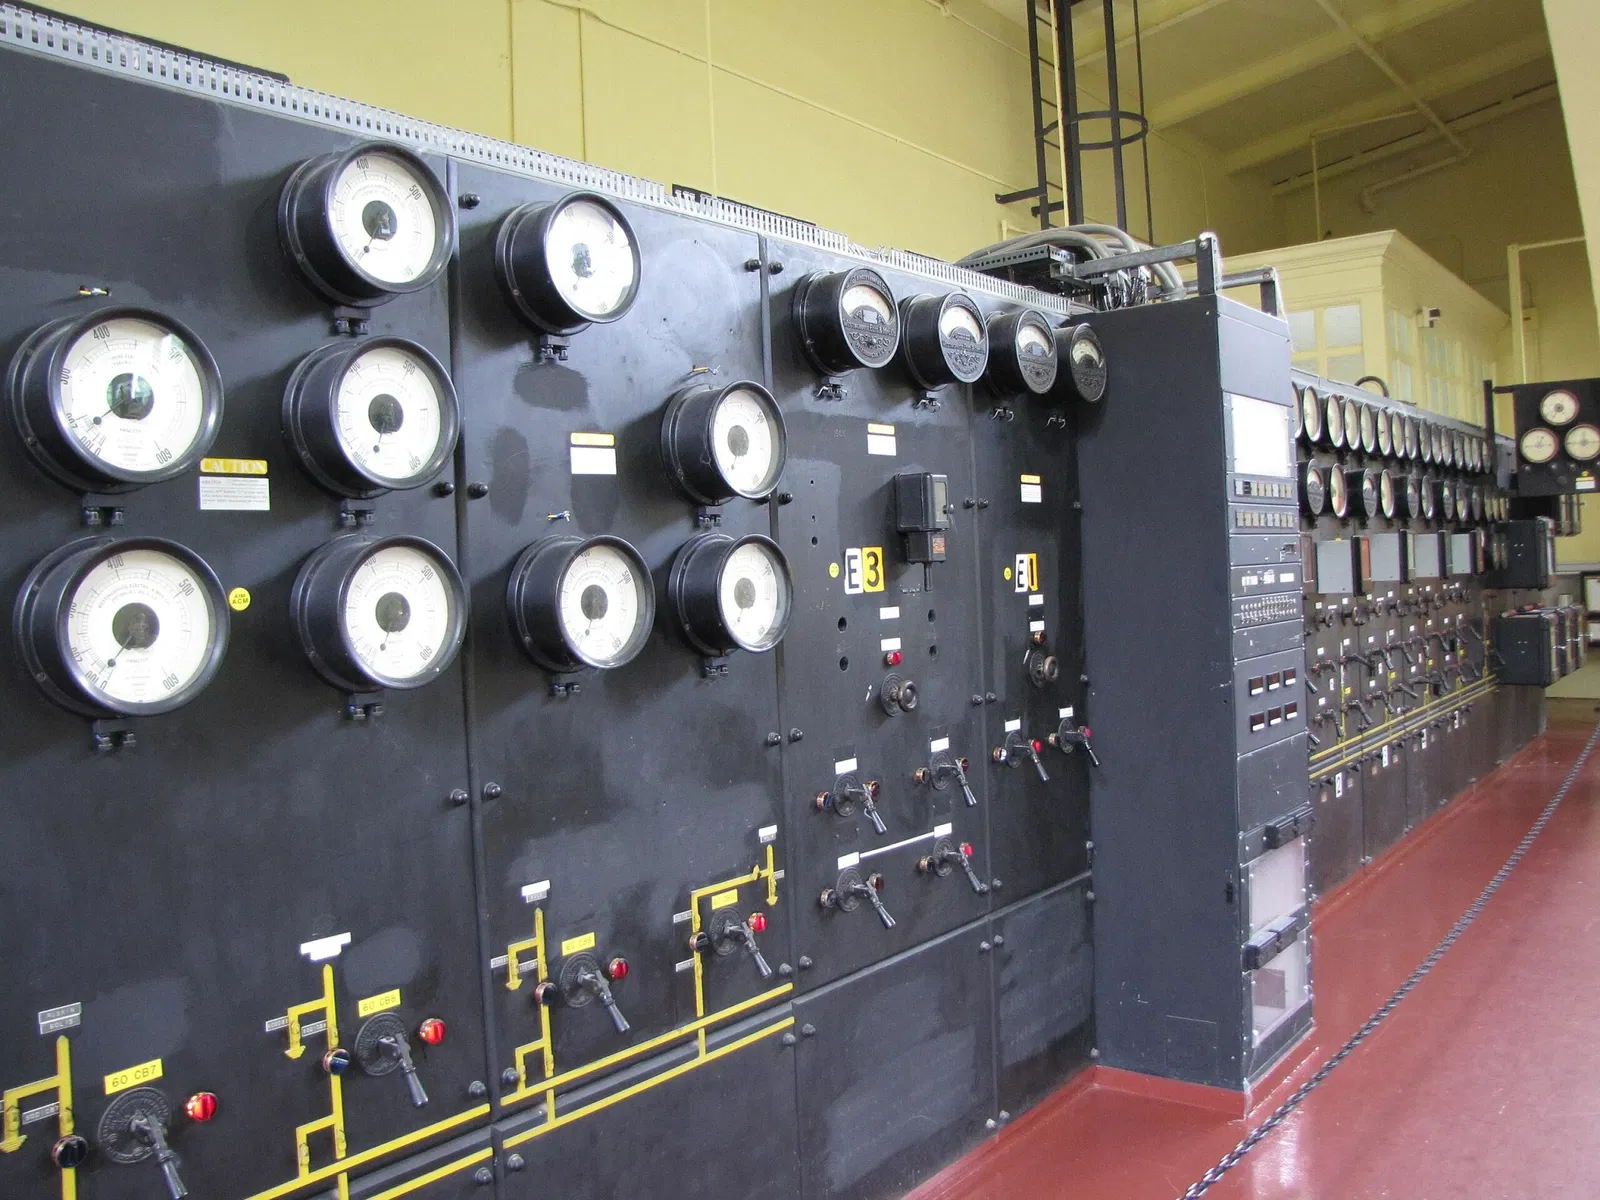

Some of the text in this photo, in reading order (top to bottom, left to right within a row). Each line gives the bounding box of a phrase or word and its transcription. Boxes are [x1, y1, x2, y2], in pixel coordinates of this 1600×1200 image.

[409, 184, 422, 200] 500
[93, 325, 110, 340] 400
[156, 448, 172, 464] 600
[201, 458, 267, 474] CAUTION
[421, 564, 434, 581] 500
[178, 578, 195, 597] 500
[420, 645, 433, 661] 600
[163, 673, 179, 691] 600
[362, 1000, 374, 1012] 60
[111, 1064, 157, 1088] 60 CB7
